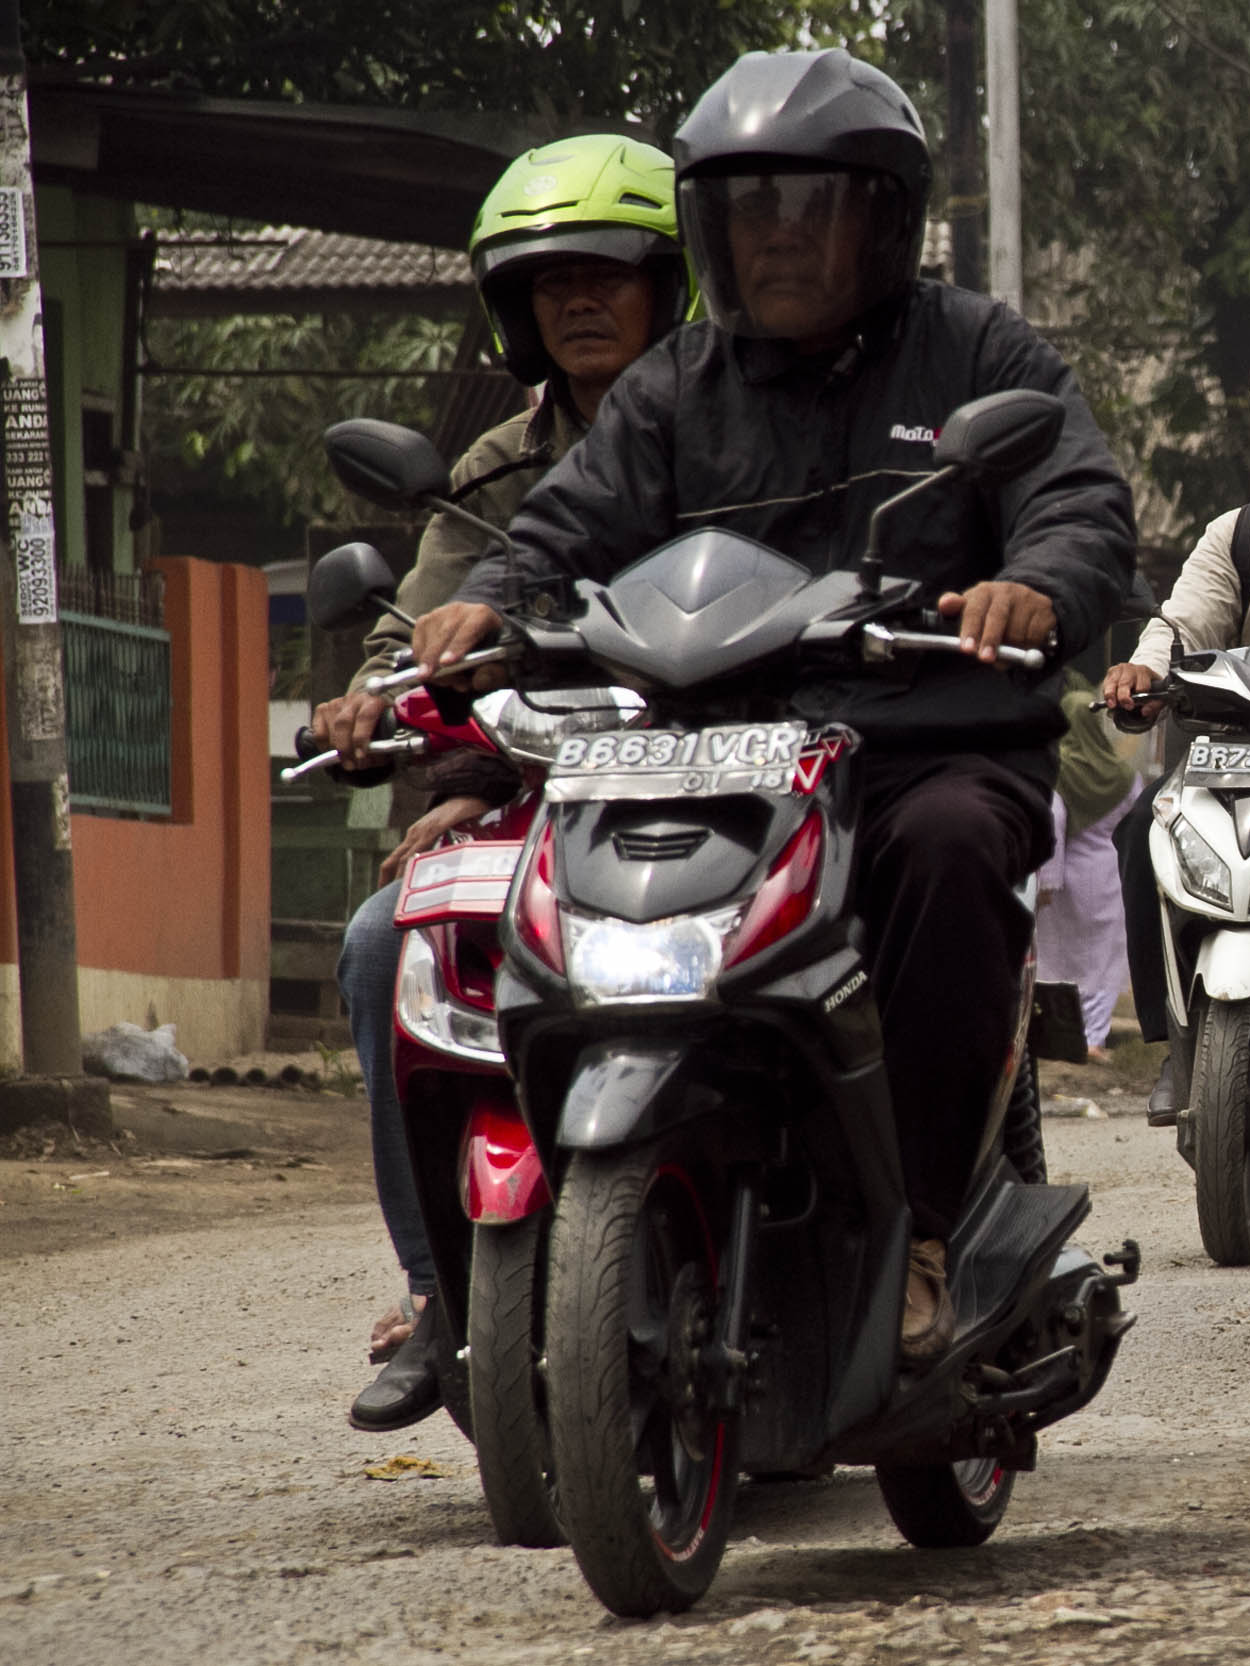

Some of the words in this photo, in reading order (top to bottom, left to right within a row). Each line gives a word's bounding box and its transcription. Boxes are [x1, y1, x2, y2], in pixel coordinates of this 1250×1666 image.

[3, 389, 39, 400] UANG
[8, 476, 44, 487] UANG
[18, 539, 29, 572] WC
[31, 538, 49, 616] 92093300
[824, 970, 868, 1013] HONDA
